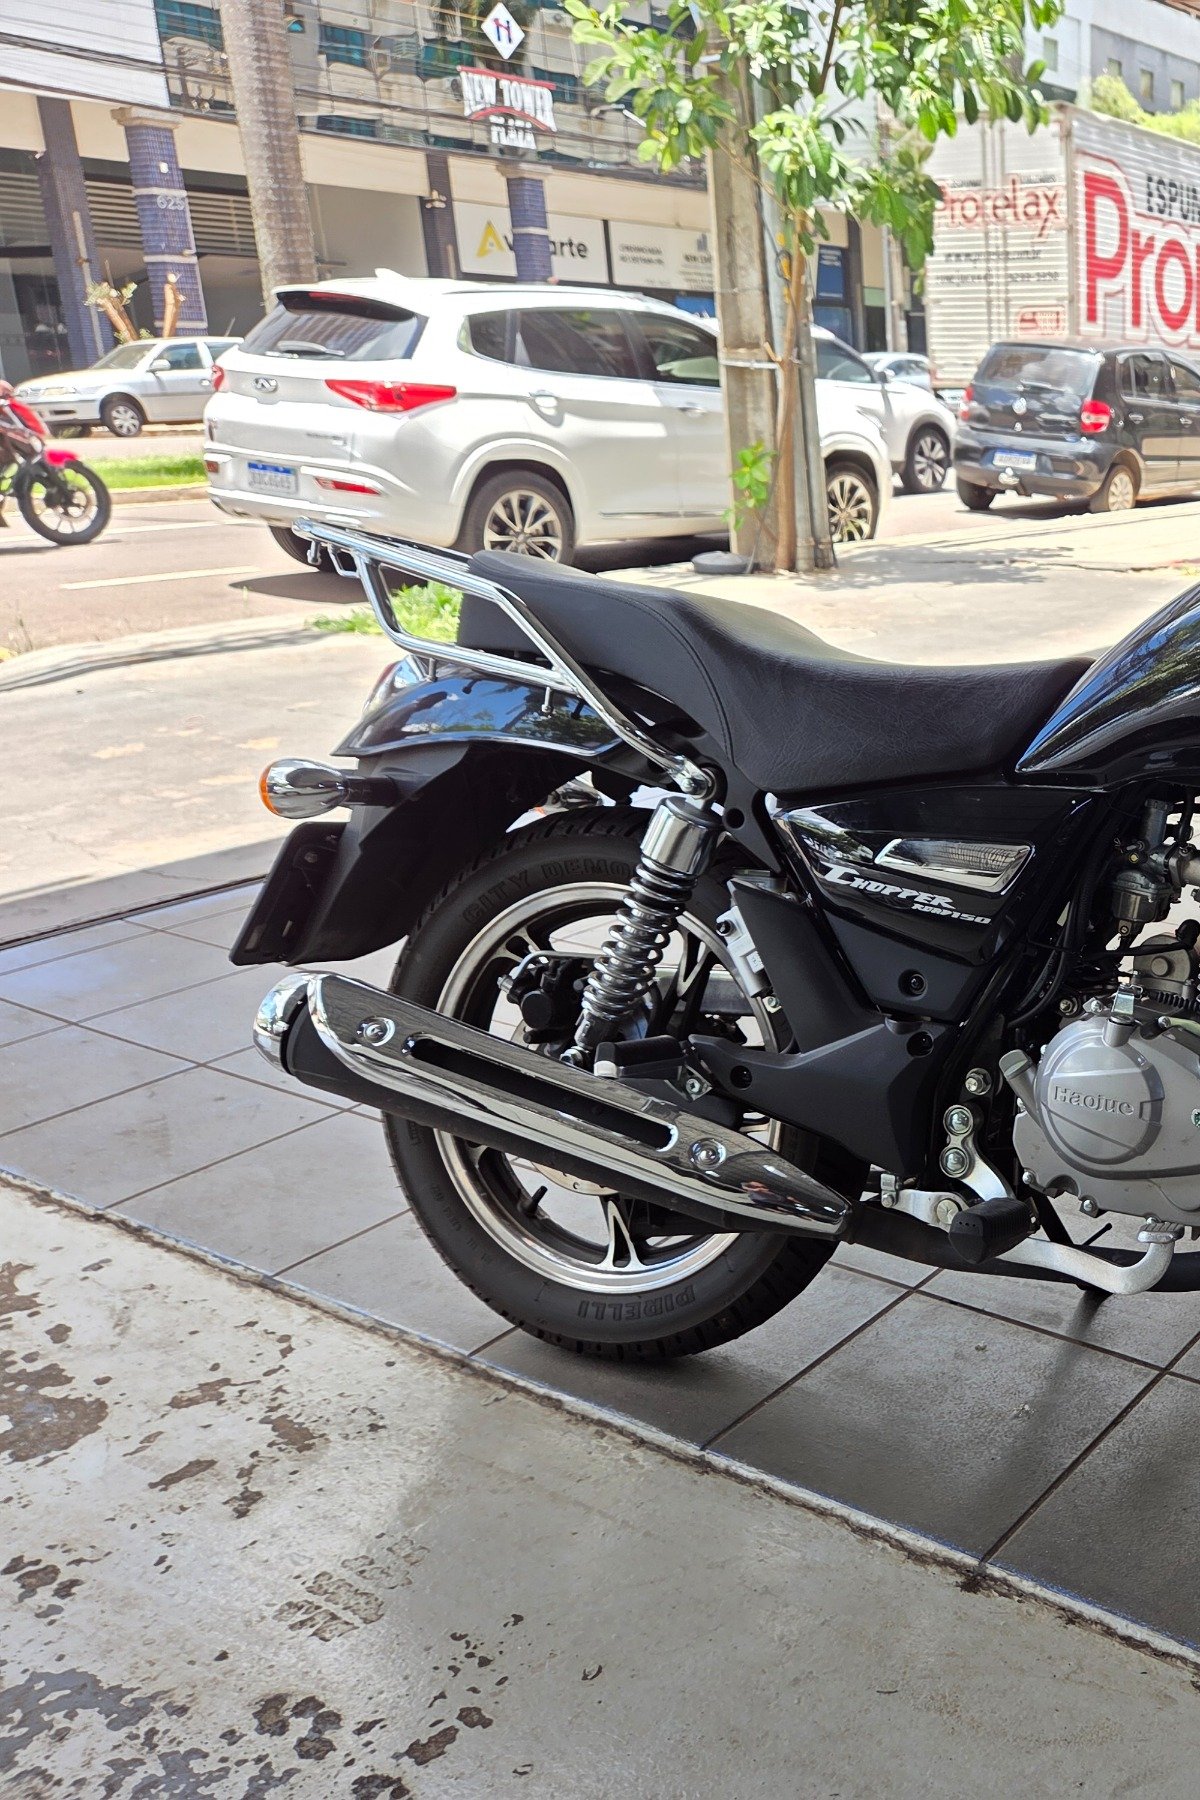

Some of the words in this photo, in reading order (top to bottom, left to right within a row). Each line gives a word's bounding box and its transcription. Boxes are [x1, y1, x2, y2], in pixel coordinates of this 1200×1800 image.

[463, 868, 530, 925] CITY
[540, 858, 635, 882] DEMO
[819, 860, 956, 910] CHOPPER
[1053, 1084, 1136, 1117] Haojue
[576, 1283, 697, 1322] PIRELLI
